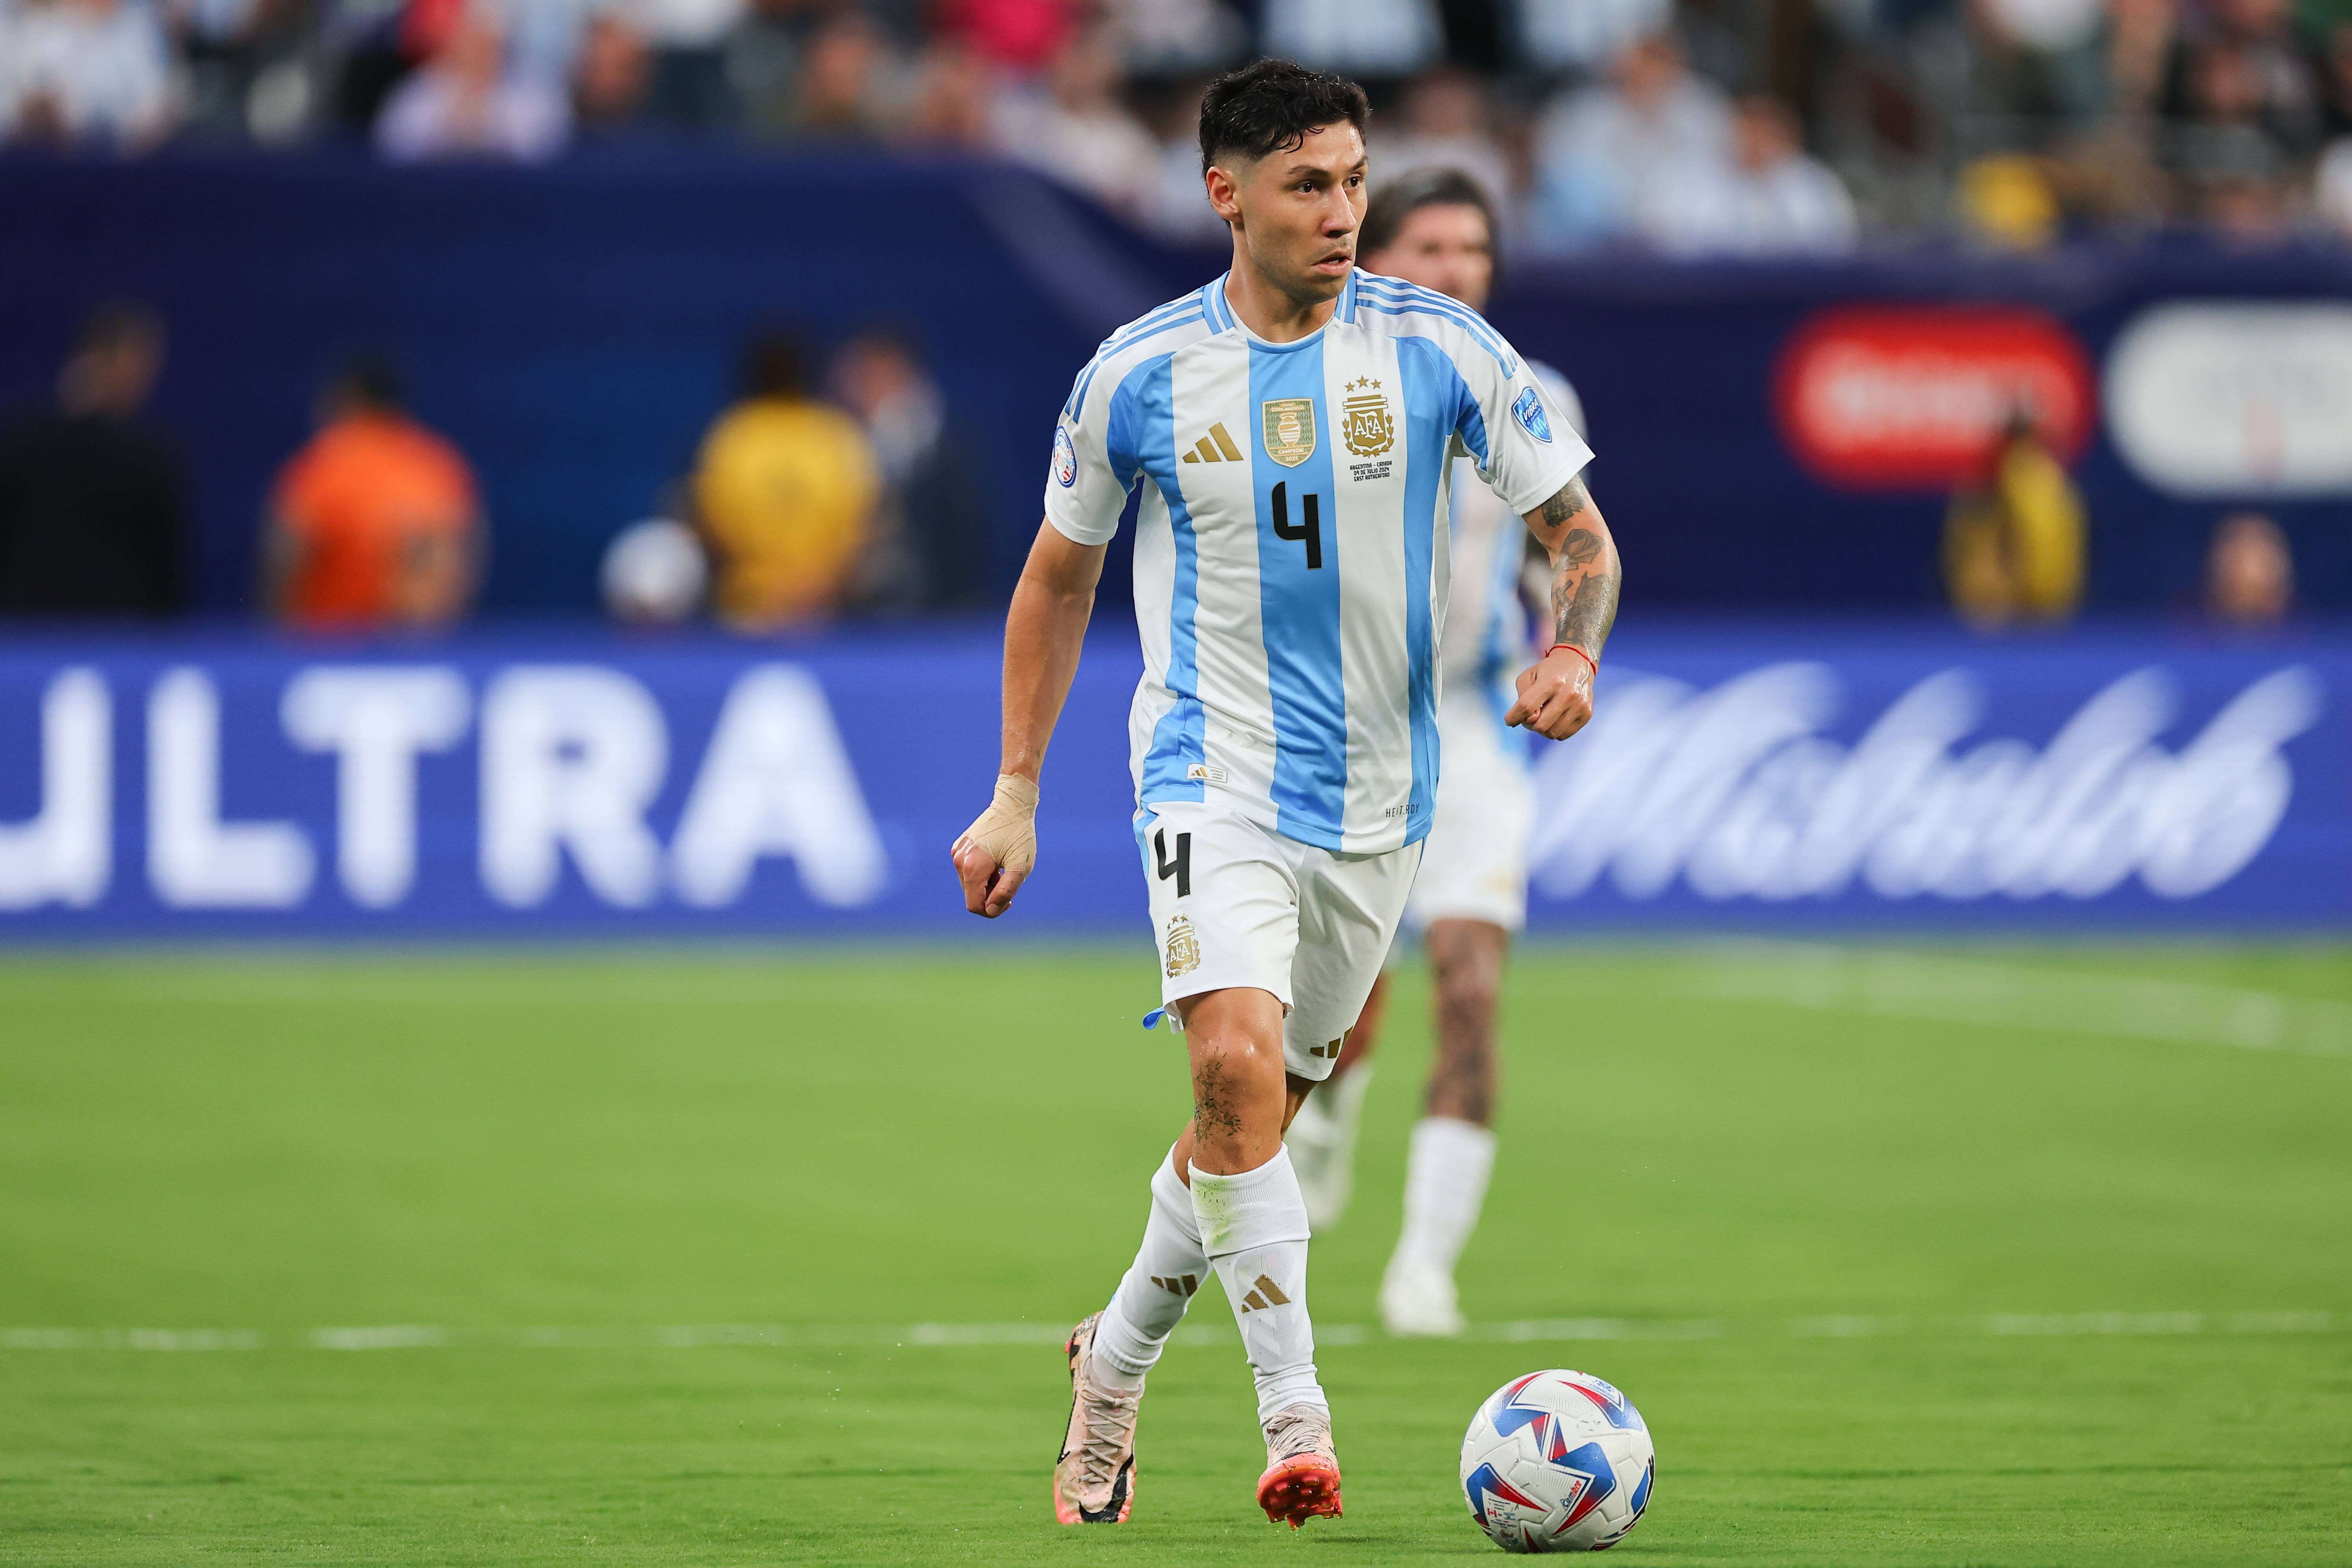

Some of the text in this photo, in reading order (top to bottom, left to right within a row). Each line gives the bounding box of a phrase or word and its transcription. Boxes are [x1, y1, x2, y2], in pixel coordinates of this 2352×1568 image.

[1523, 397, 1539, 421] VIBRA
[1354, 411, 1384, 439] AFA
[1271, 481, 1322, 569] 4
[1154, 827, 1191, 898] 4
[1170, 939, 1191, 963] AFA
